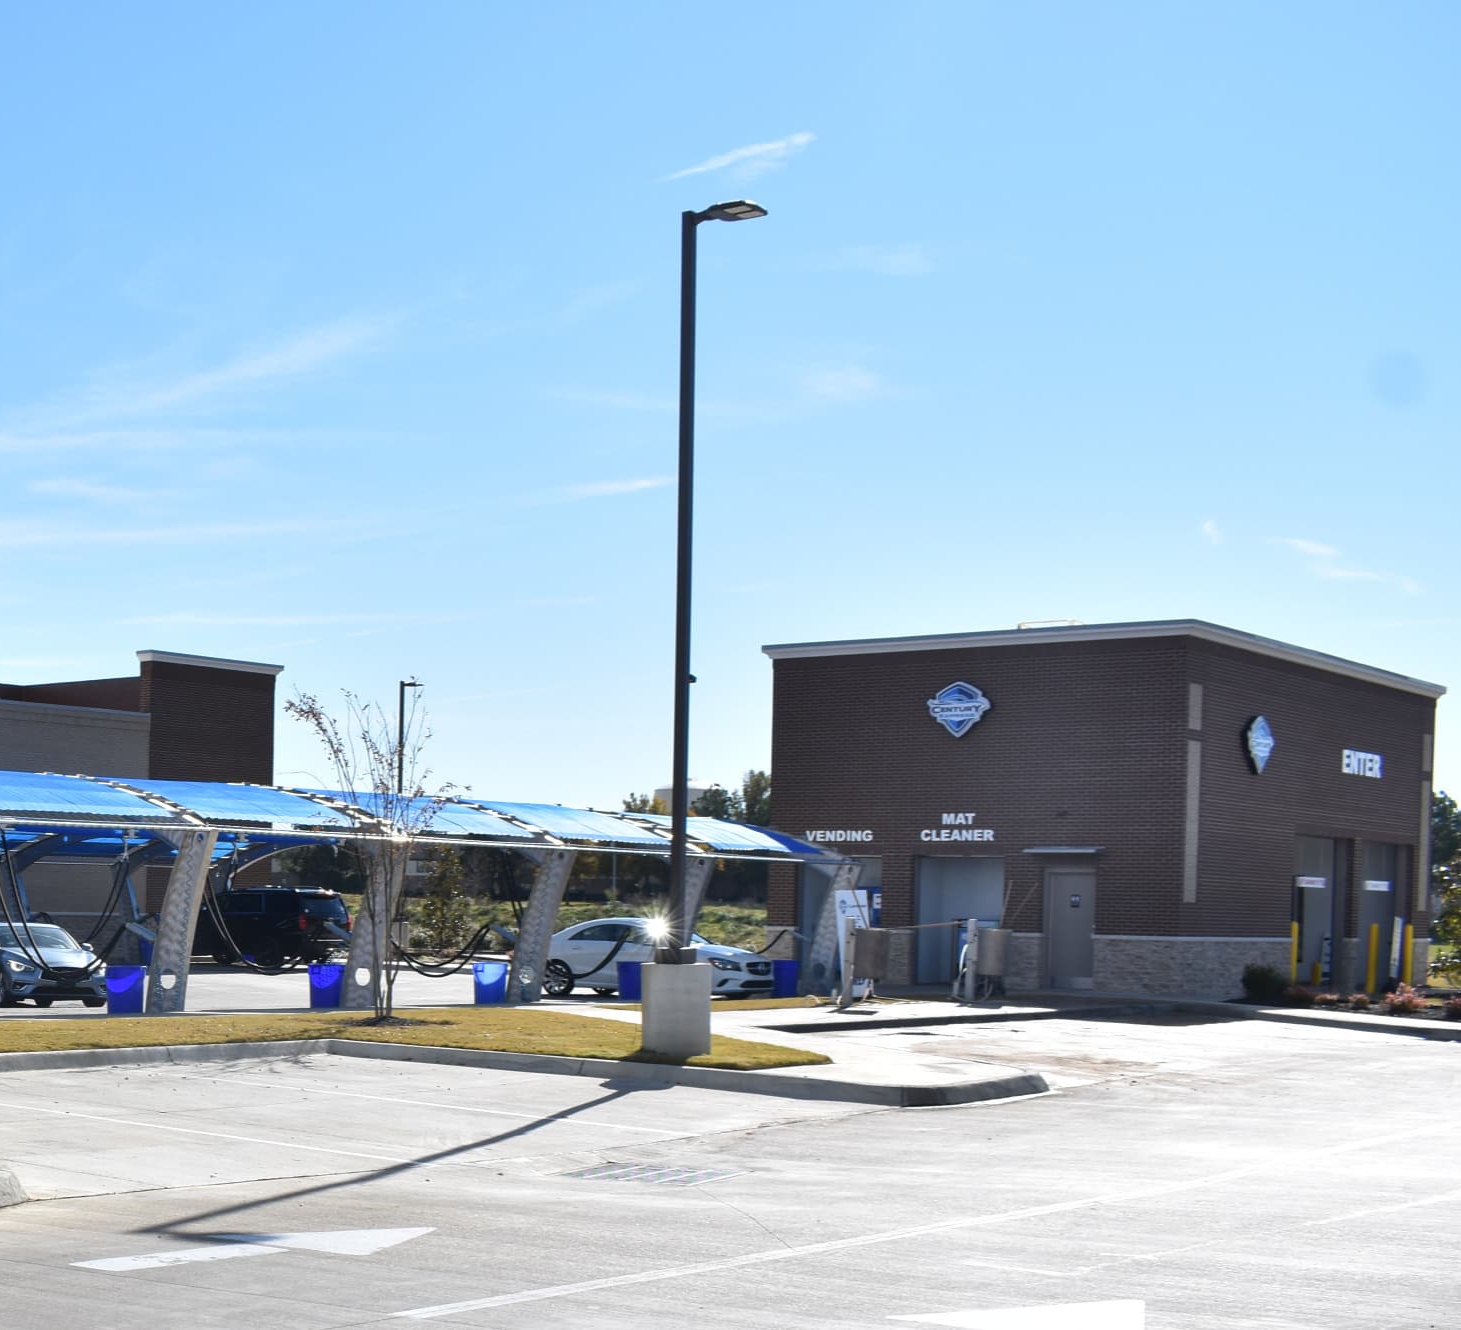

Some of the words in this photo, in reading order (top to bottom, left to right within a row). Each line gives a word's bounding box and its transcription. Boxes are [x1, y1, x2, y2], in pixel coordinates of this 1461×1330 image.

[1341, 749, 1383, 778] ENTER
[941, 812, 976, 825] MAT
[805, 830, 874, 842] VENDING
[920, 829, 995, 842] CLEANER
